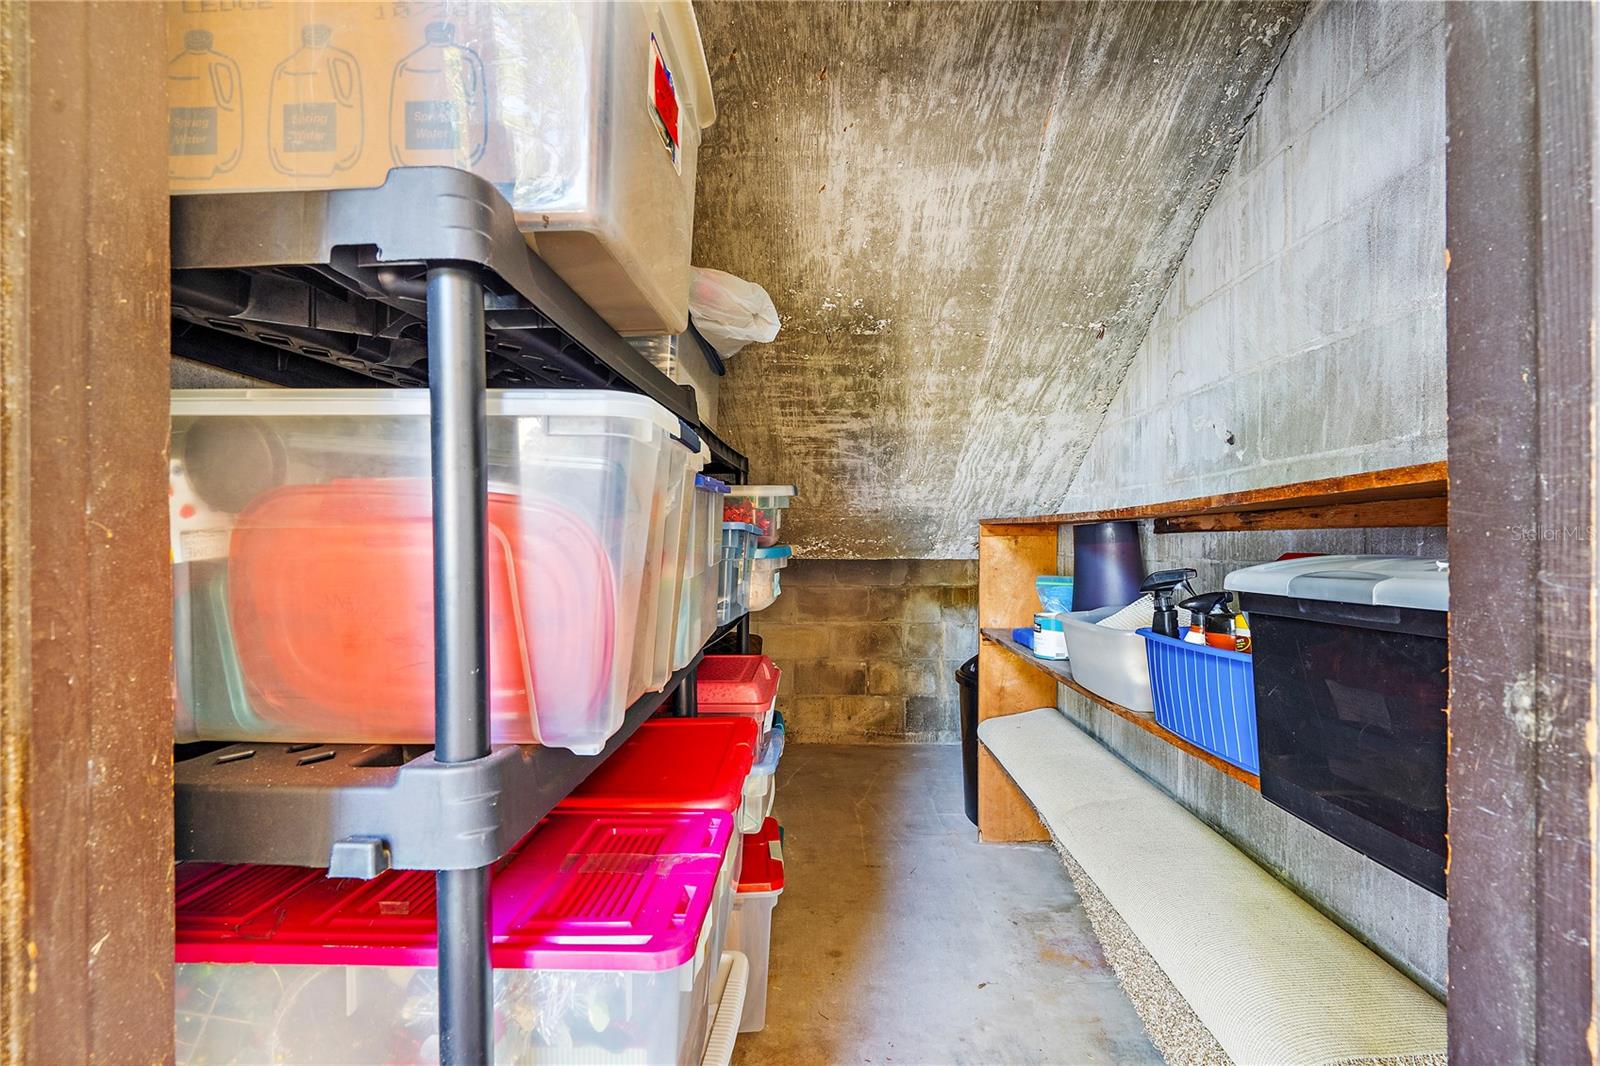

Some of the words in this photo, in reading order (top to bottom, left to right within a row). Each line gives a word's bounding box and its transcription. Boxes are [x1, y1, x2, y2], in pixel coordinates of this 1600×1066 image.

[174, 117, 209, 130] Spring
[415, 127, 449, 138] Water
[174, 133, 207, 144] Water
